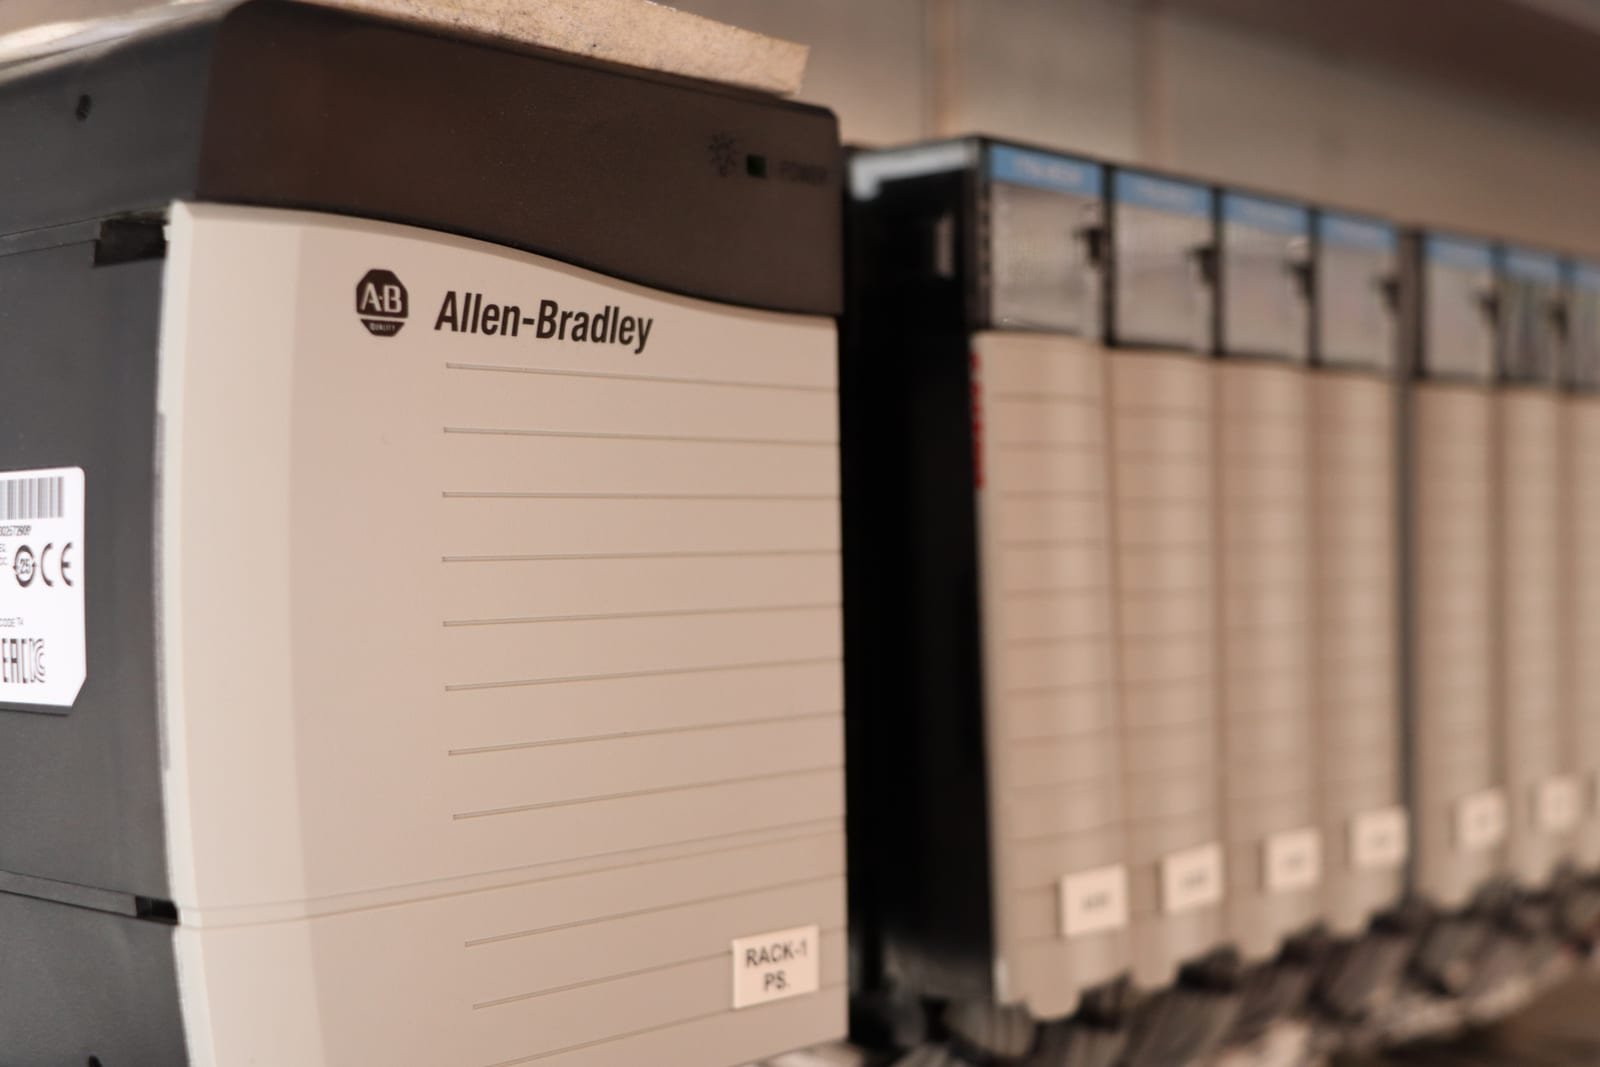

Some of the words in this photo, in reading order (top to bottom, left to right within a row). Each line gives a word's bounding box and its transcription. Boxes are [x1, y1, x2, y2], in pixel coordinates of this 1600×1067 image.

[434, 290, 653, 354] Allen-Bradley
[41, 541, 74, 587] CE
[746, 939, 807, 967] RACK-1
